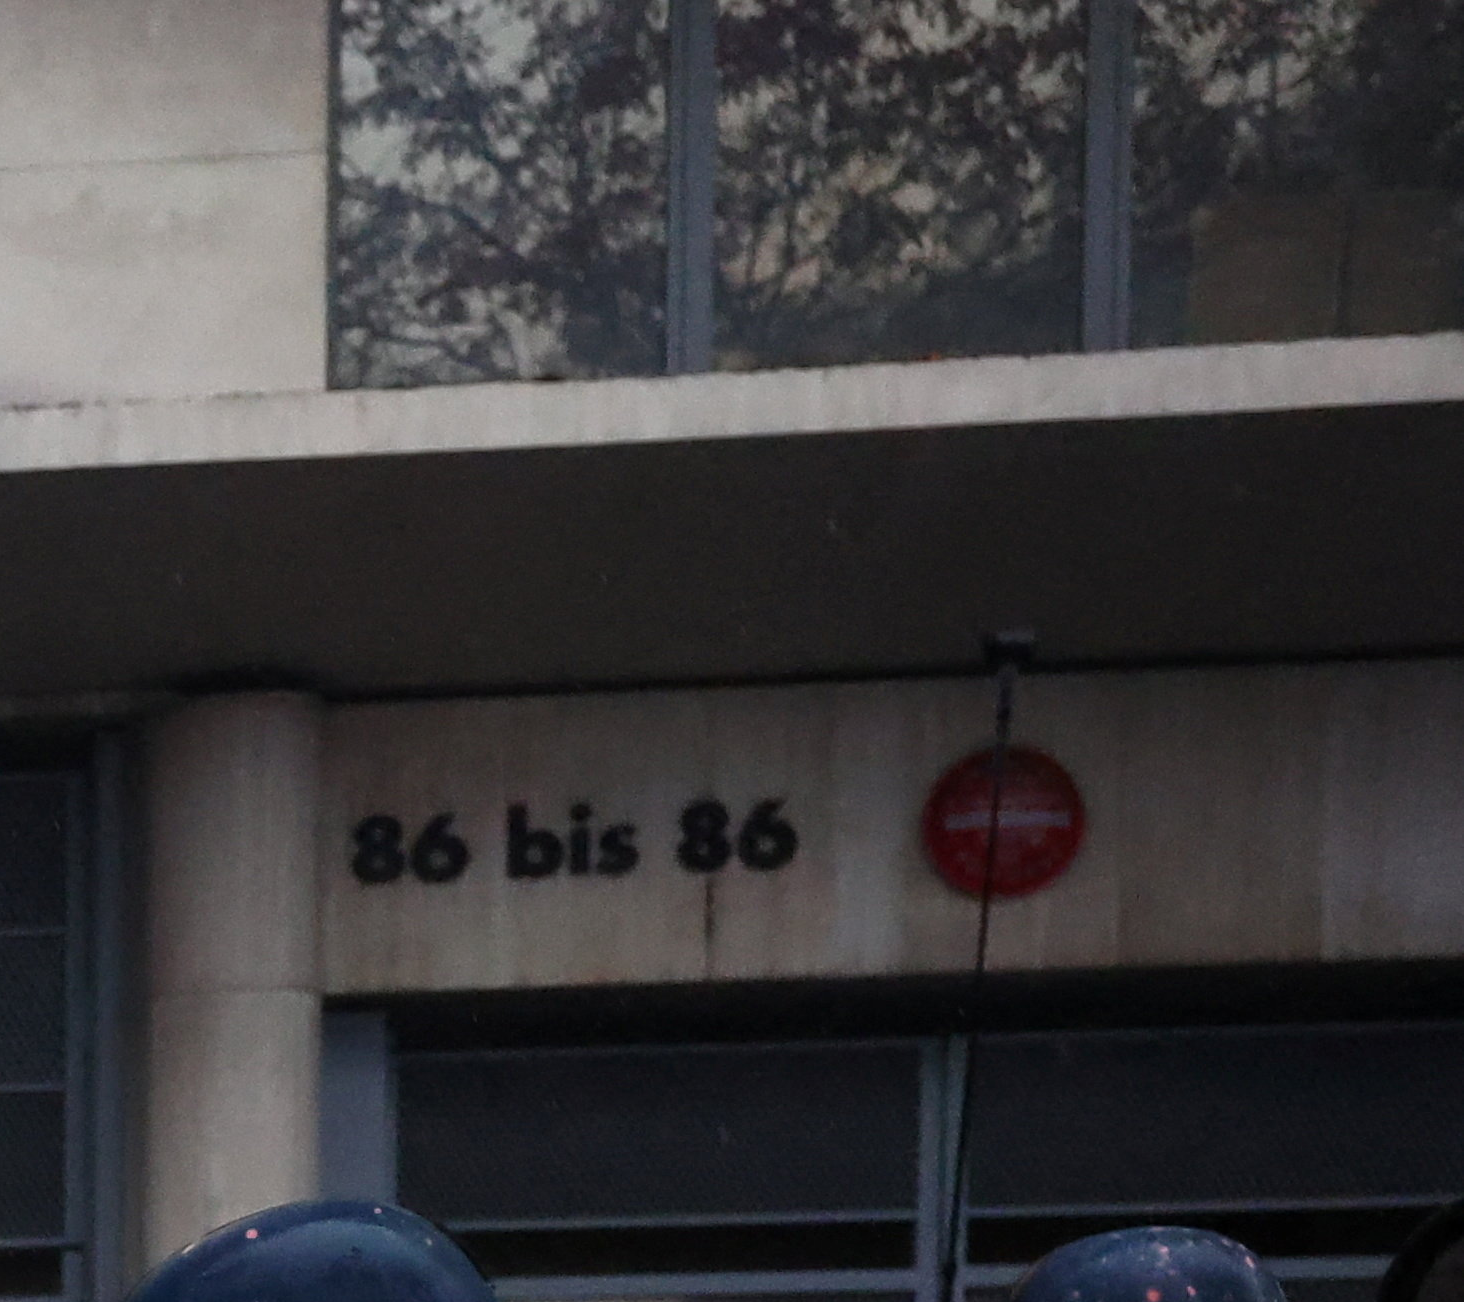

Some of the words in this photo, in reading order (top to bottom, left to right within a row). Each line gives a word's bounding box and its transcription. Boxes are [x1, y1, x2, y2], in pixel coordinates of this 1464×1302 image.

[351, 813, 471, 885] 86
[505, 803, 640, 880] bis
[675, 798, 799, 874] 86
